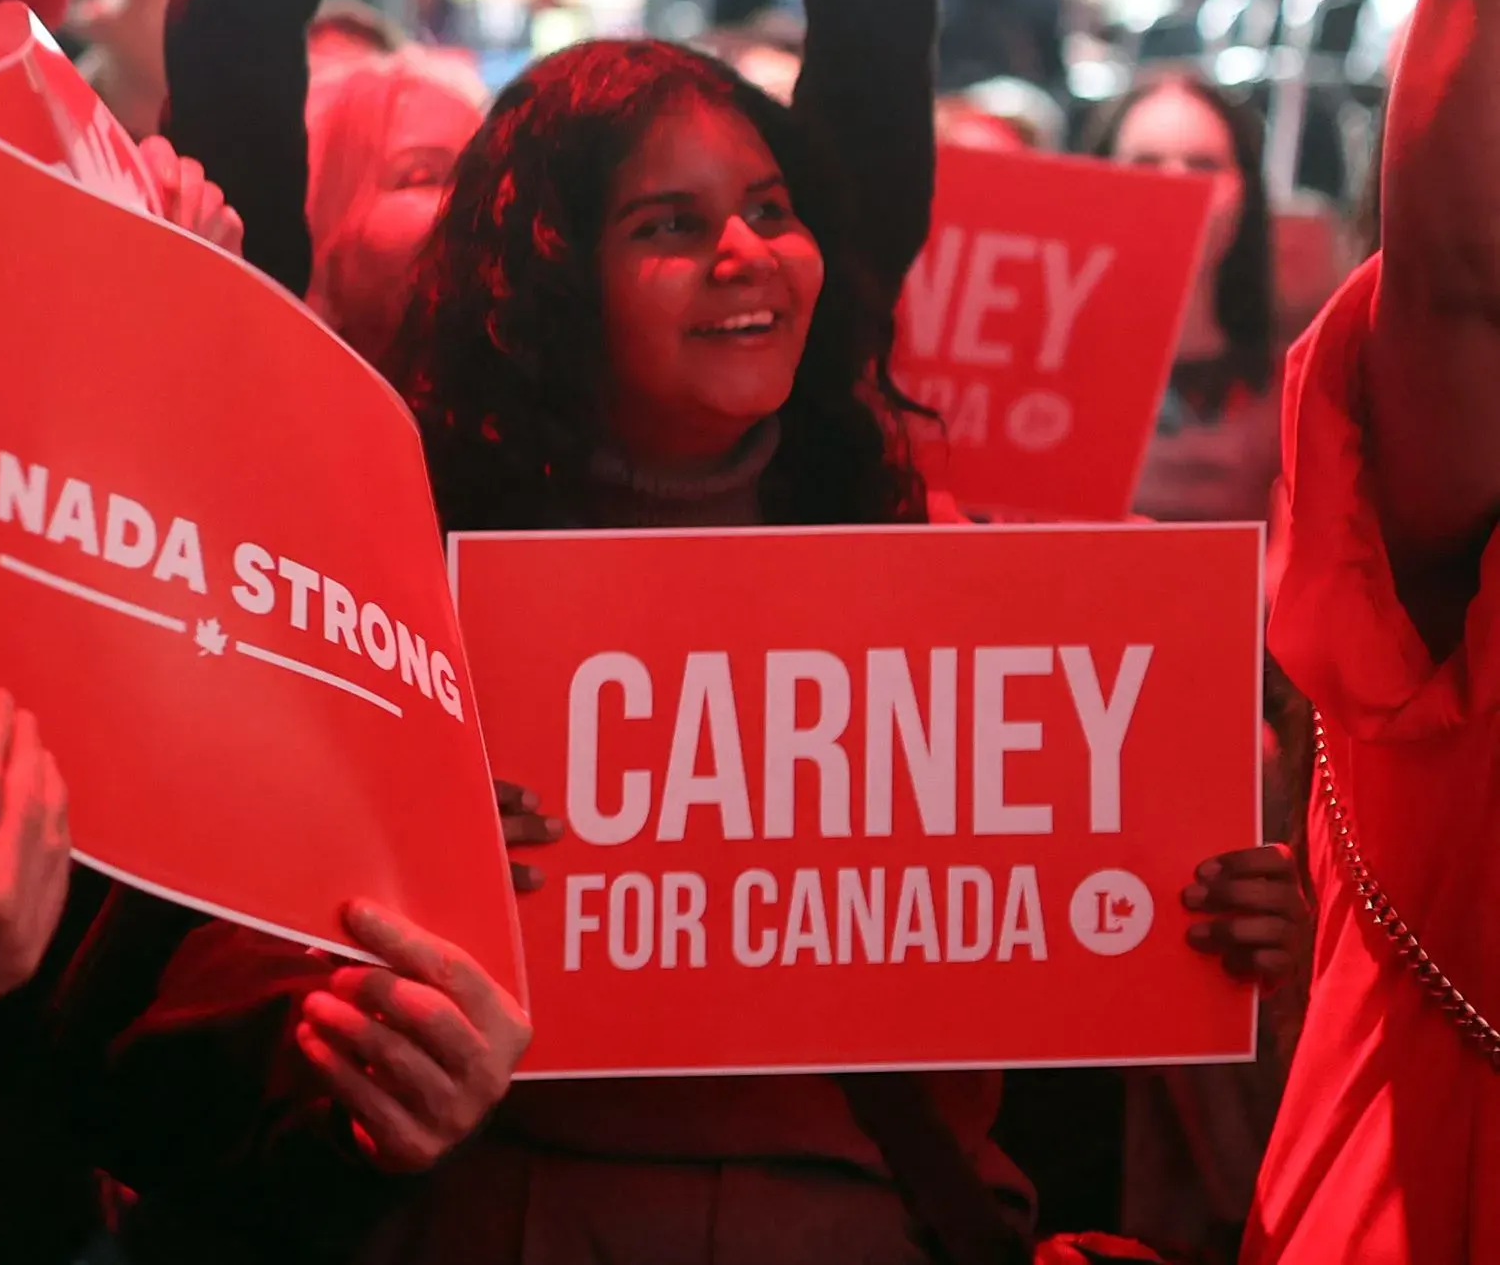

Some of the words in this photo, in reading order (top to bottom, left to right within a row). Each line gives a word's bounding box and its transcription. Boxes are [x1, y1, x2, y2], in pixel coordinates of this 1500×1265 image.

[230, 541, 466, 724] STRONG
[566, 644, 1154, 846] CARNEY
[563, 871, 708, 971] FOR
[731, 865, 1048, 968] CANADA
